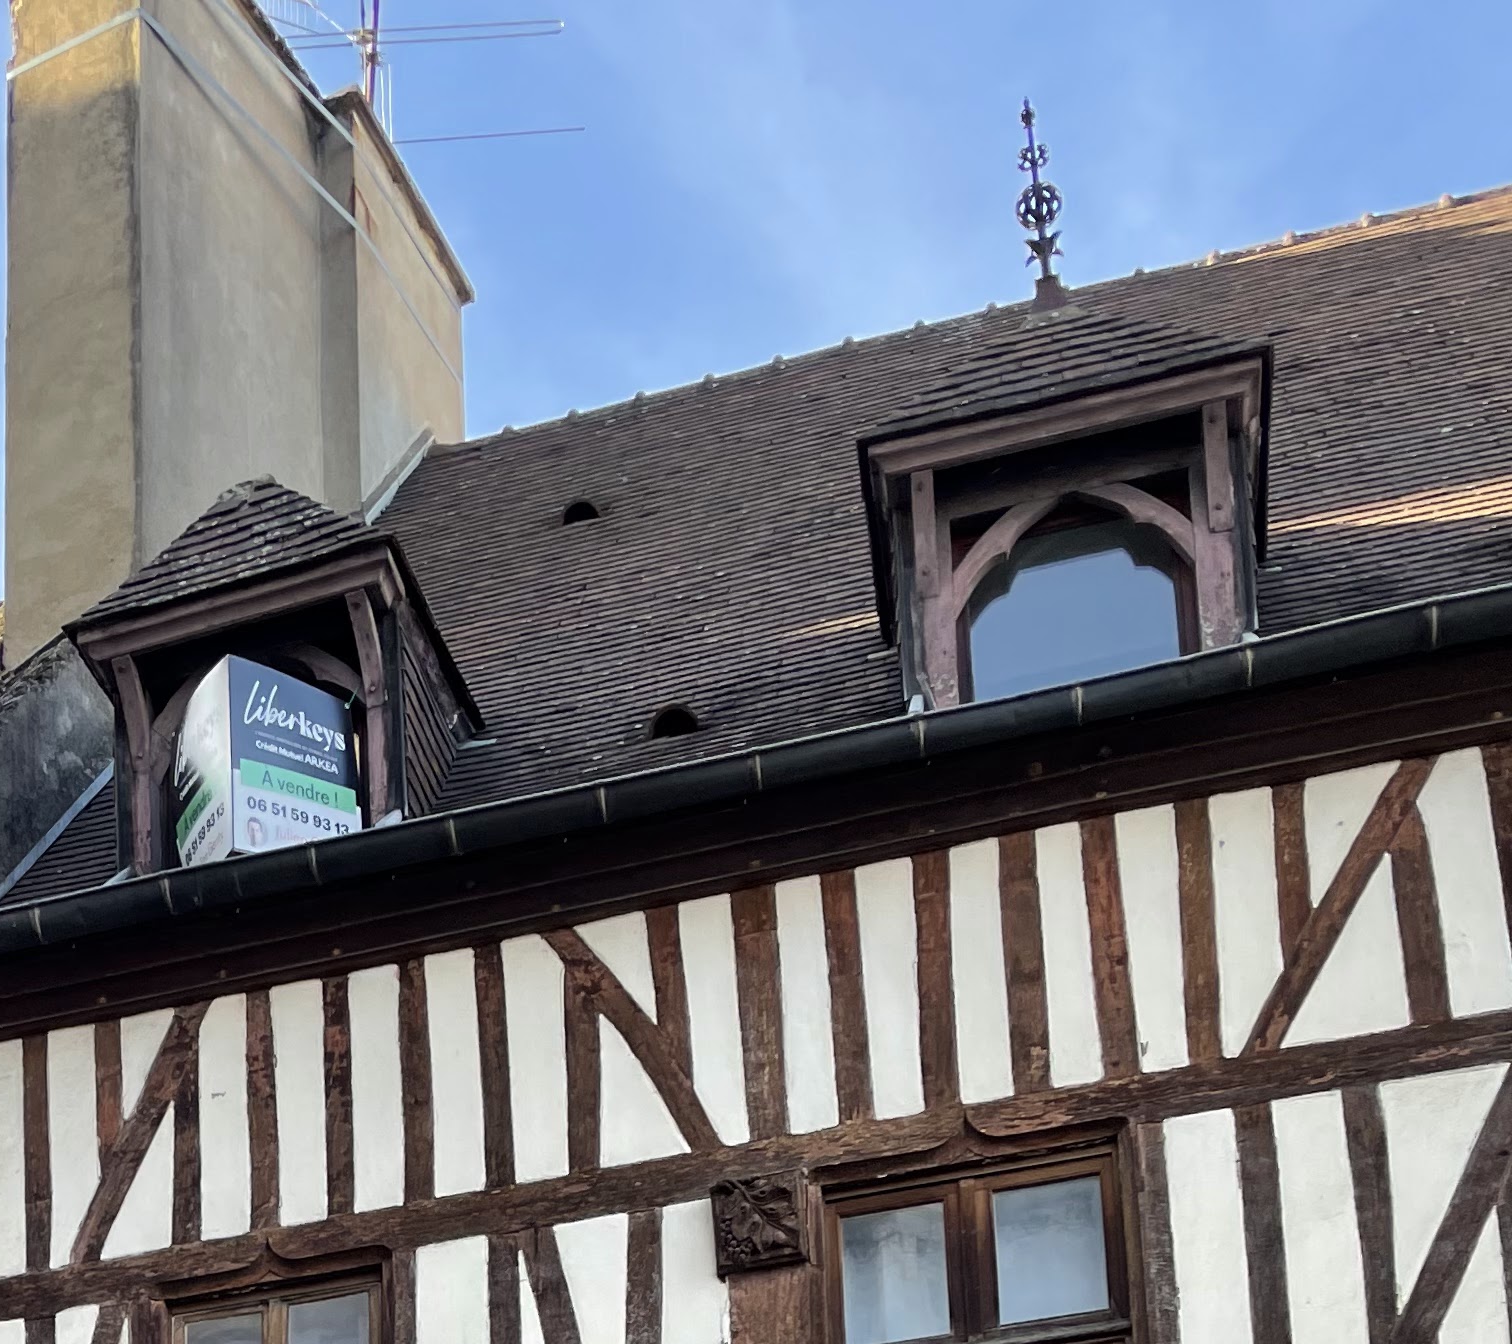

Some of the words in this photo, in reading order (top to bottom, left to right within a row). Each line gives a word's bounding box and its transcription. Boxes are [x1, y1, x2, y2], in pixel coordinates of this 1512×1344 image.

[244, 680, 346, 751] liberkeys
[304, 754, 339, 774] ARKEA
[277, 778, 330, 805] vendre
[334, 791, 339, 808] !
[247, 796, 267, 812] 06
[271, 802, 287, 818] 51
[291, 807, 309, 824] 59
[313, 815, 331, 831] 93
[335, 822, 350, 835] 13
